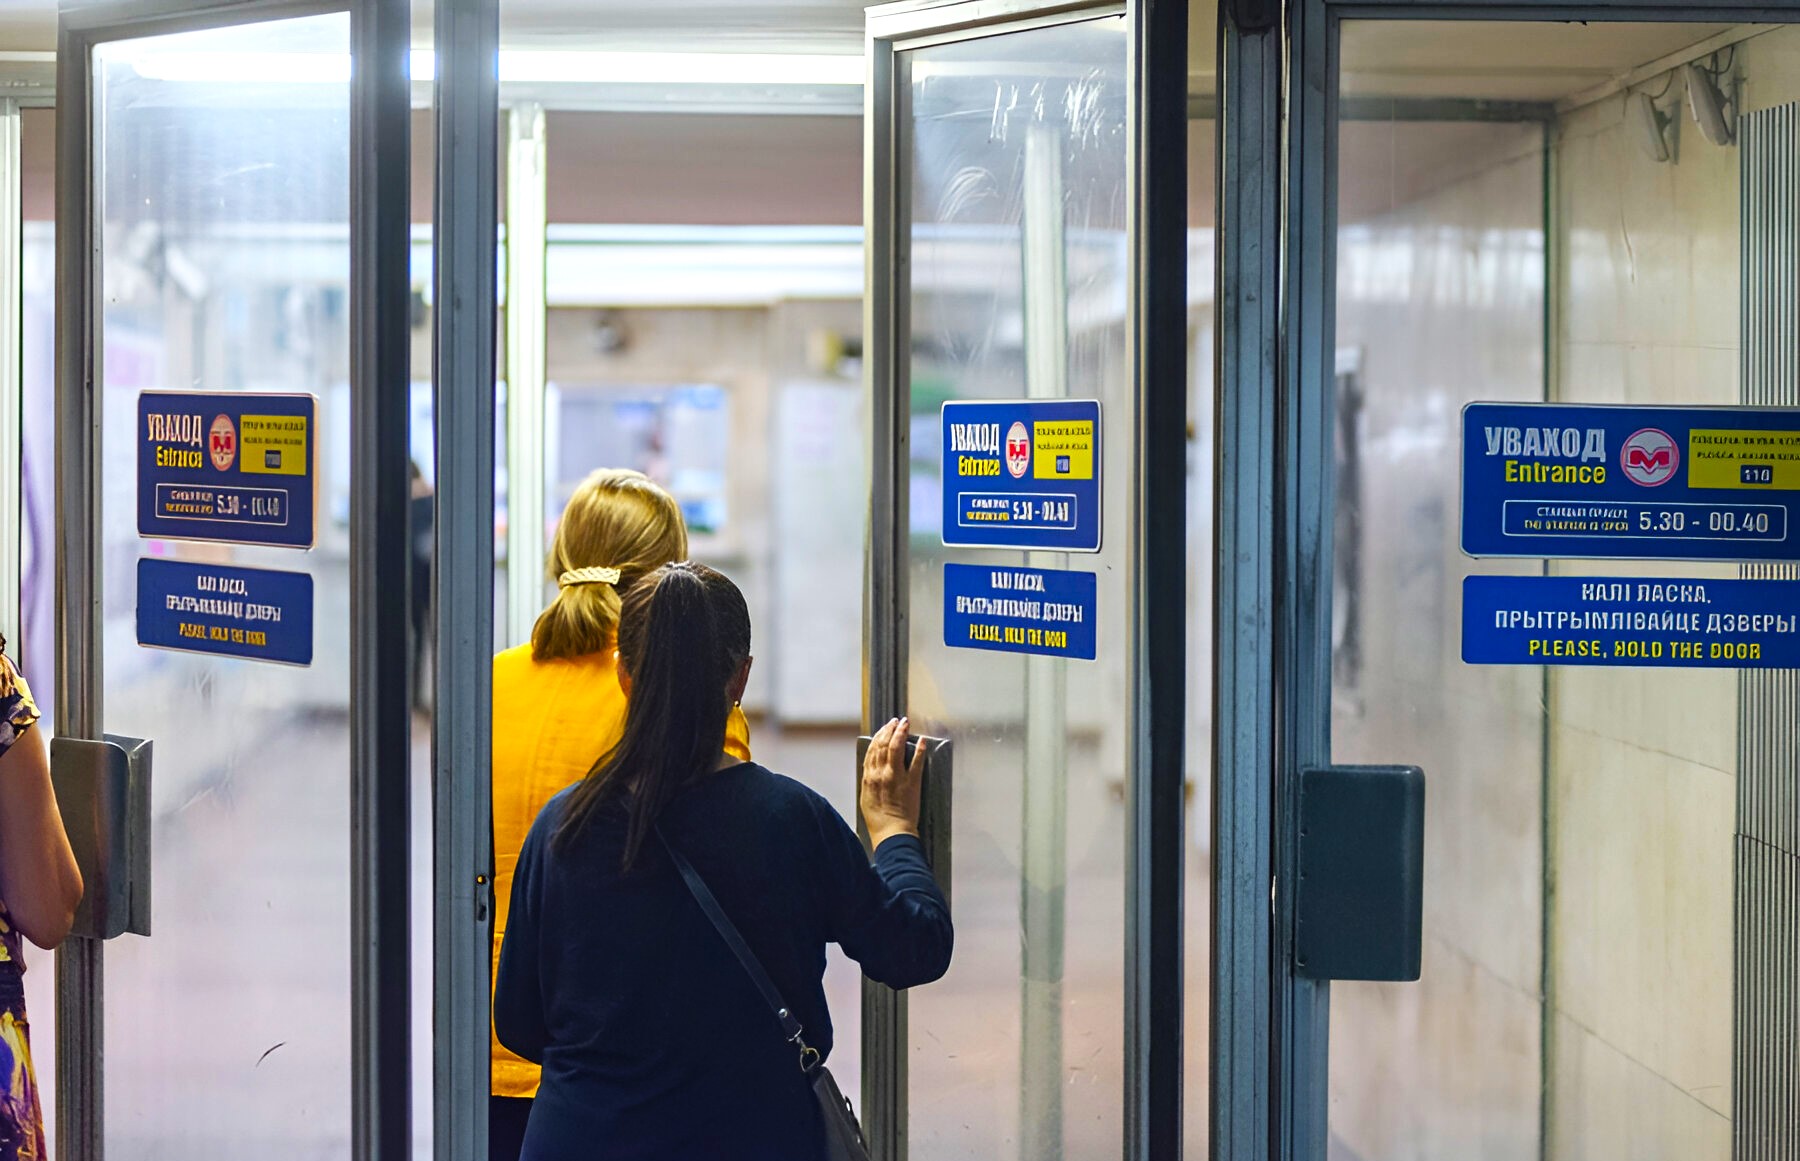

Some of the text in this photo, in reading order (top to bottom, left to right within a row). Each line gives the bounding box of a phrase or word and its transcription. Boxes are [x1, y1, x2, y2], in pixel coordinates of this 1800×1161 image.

[1484, 426, 1607, 463] УВАХОД
[1505, 460, 1606, 484] Entrance
[1639, 511, 1685, 532] 5.30
[1709, 512, 1769, 533] 00.40
[1706, 613, 1796, 634] ДЗВЕРЫ
[1529, 640, 1760, 659] PLEASE, HOLD THE DOOR
